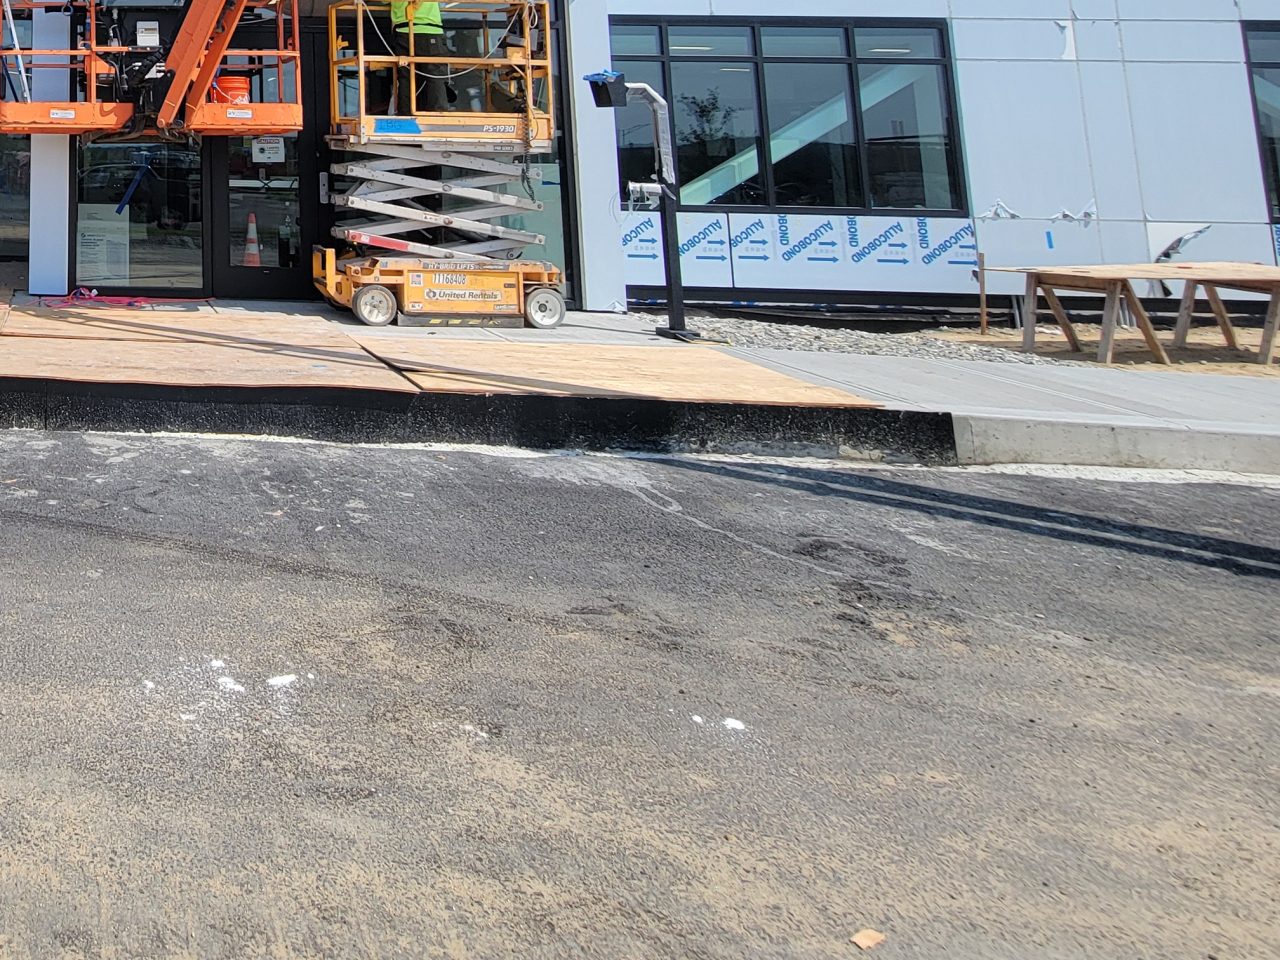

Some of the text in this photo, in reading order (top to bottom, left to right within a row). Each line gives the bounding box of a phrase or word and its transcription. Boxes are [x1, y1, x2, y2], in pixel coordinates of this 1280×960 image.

[781, 220, 834, 262] ALUCOBOND
[851, 221, 904, 264] ALUCOBOND
[921, 222, 974, 265] ALUCOBOND
[433, 273, 466, 285] 11168408
[438, 290, 498, 300] United Rentals
